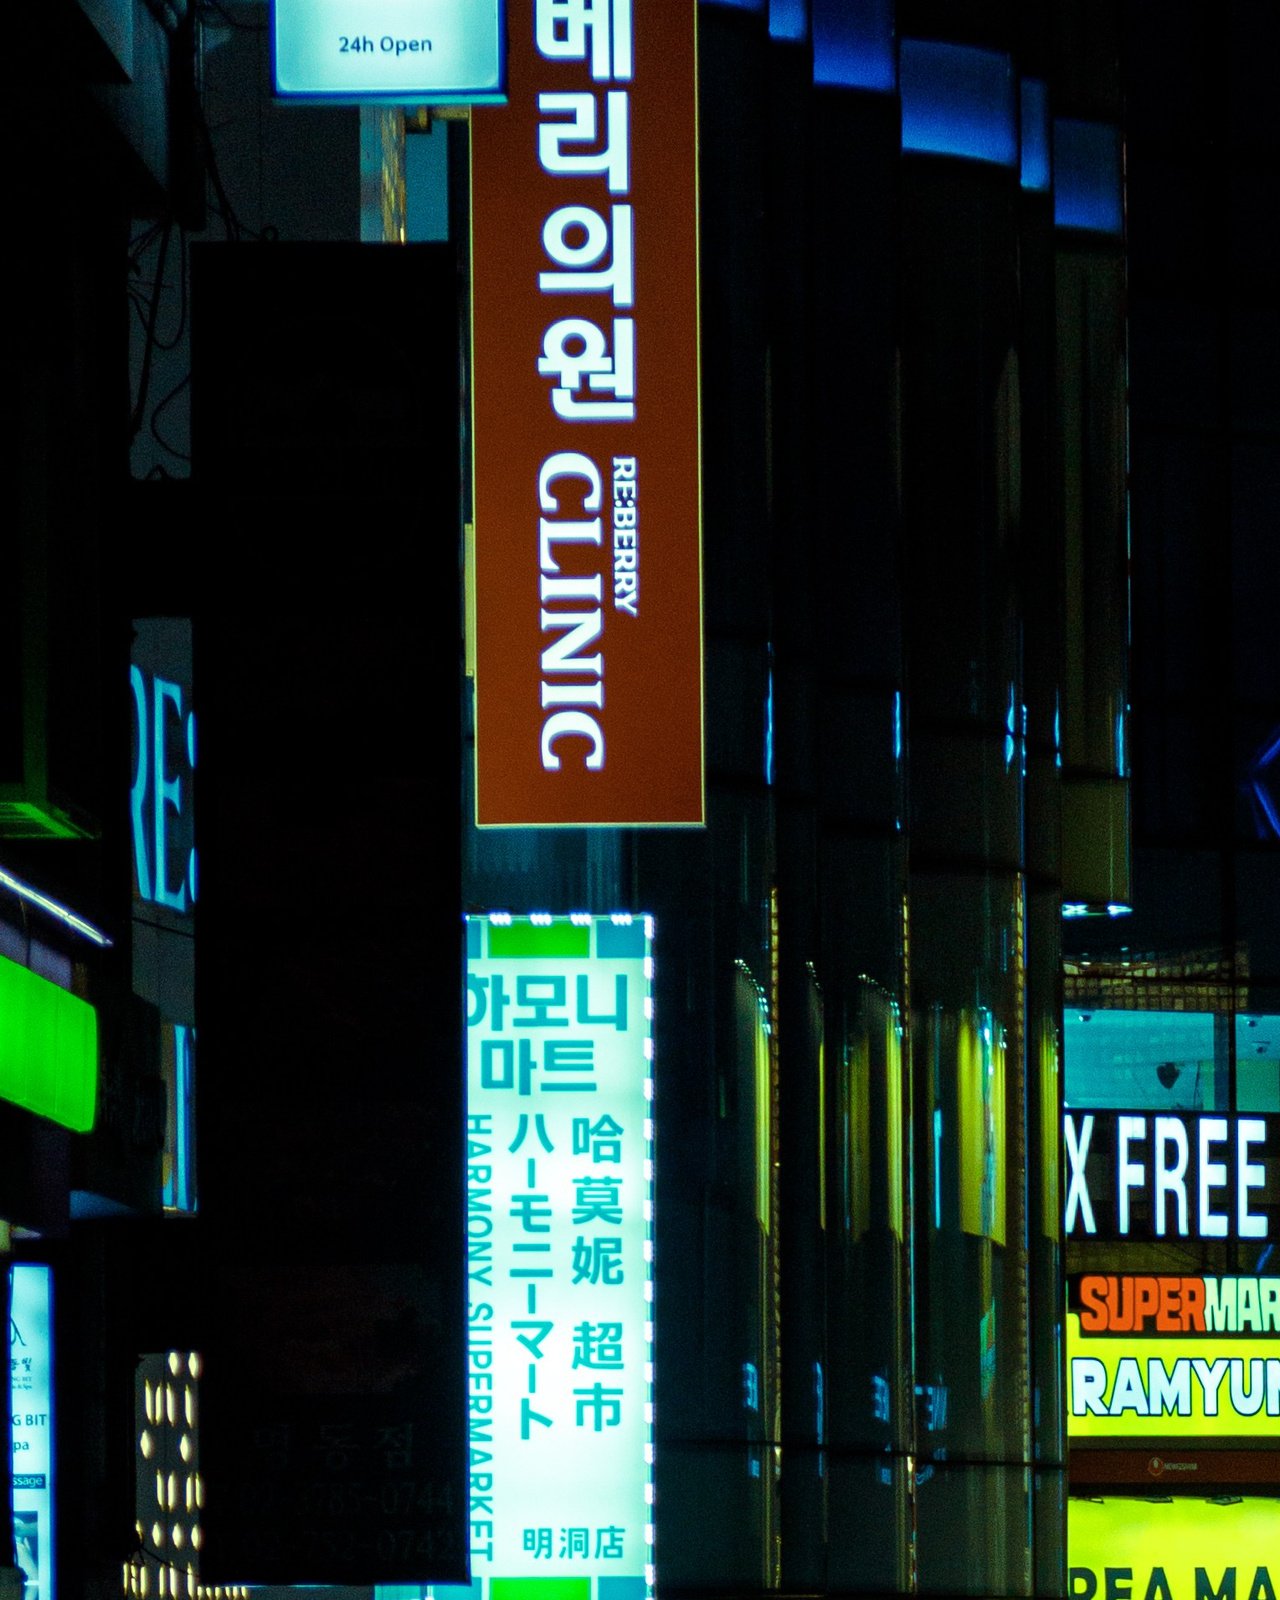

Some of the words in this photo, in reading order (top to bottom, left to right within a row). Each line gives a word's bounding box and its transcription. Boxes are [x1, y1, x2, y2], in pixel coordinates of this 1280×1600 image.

[339, 36, 375, 53] 24h
[380, 36, 434, 57] Open
[611, 456, 640, 618] RE:BERRY
[538, 452, 606, 771] CLINIC
[467, 973, 630, 1033] 하모니
[480, 1038, 598, 1096] 마트
[467, 1114, 494, 1289] HARMONY
[1117, 1115, 1268, 1238] FREE
[509, 1113, 556, 1442] ハーモニーマート
[25, 1413, 47, 1426] BIT
[468, 1301, 494, 1562] SUPERMARKET
[523, 1526, 626, 1561] 明洞店
